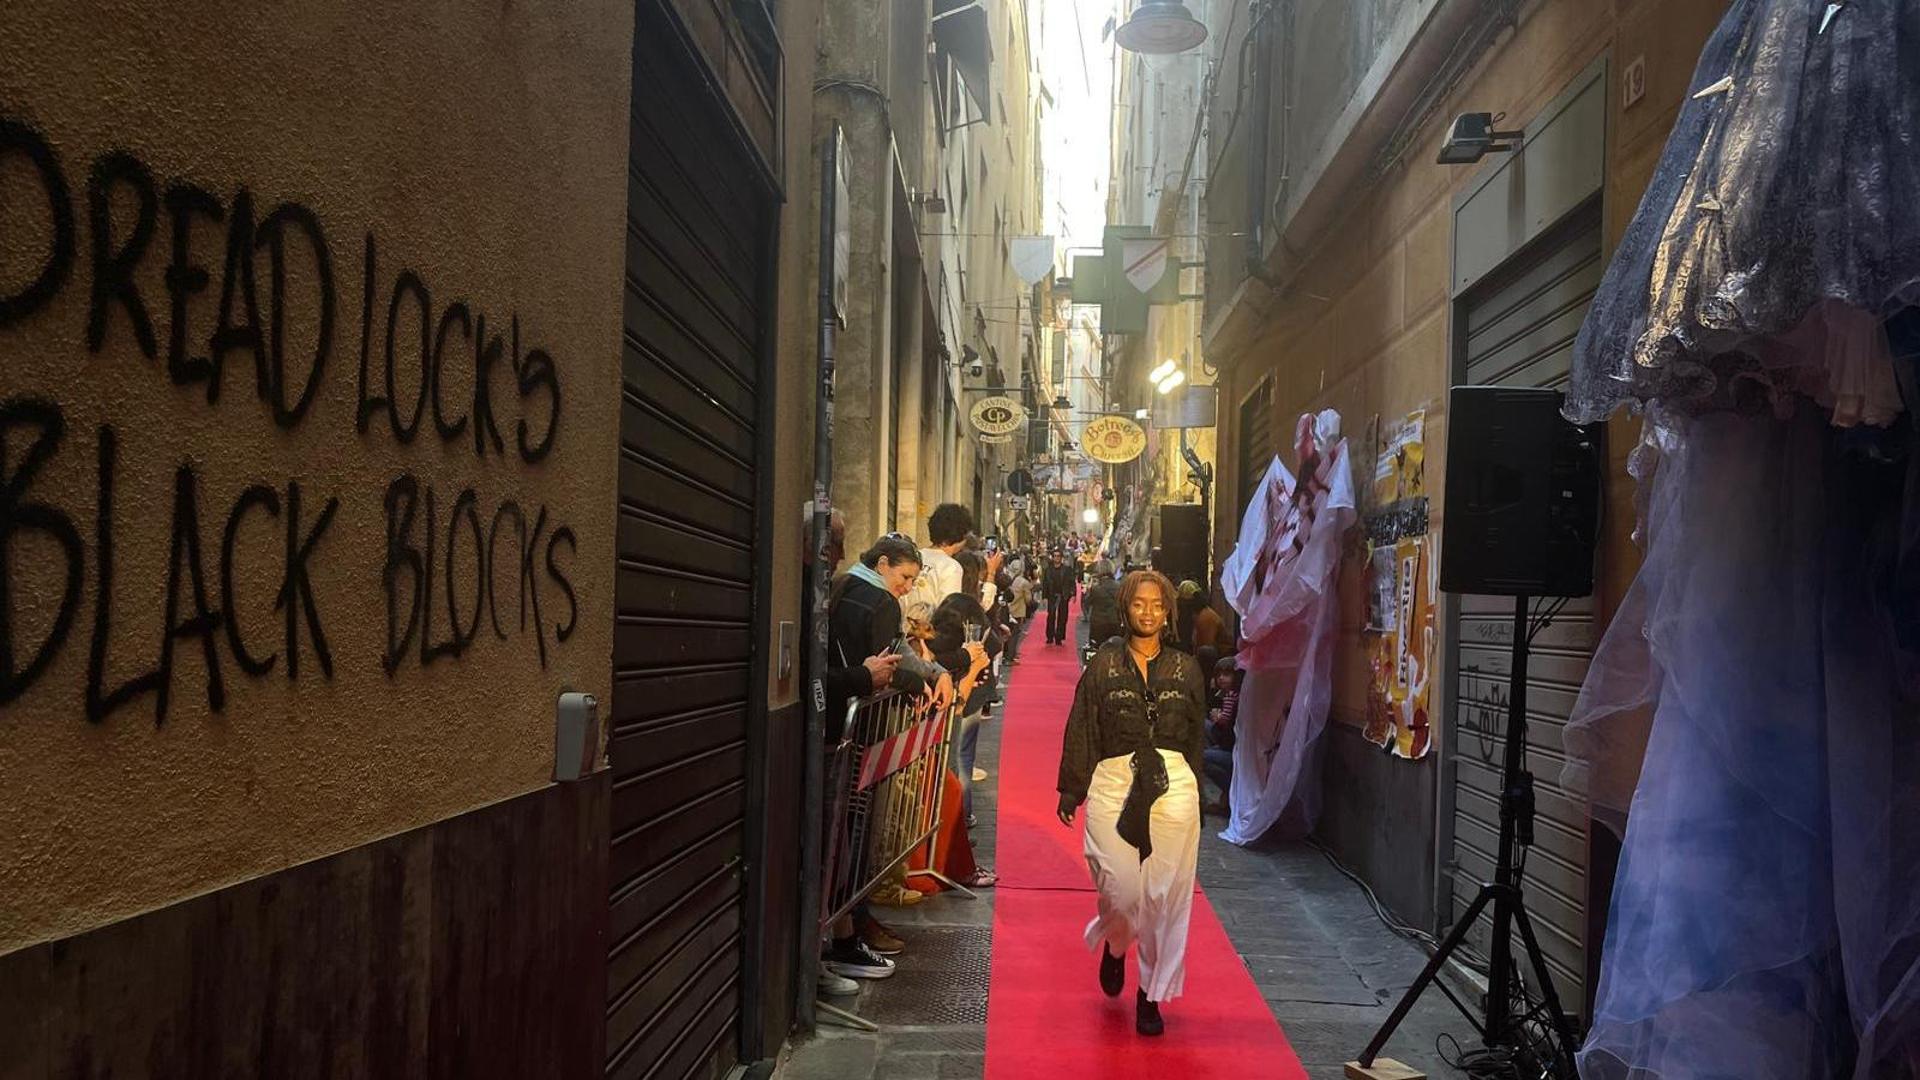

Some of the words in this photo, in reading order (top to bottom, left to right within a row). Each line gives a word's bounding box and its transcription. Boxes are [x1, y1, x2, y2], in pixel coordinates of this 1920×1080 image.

[1625, 64, 1643, 102] 19
[0, 395, 337, 728] BLACK
[383, 474, 577, 672] BLOCKS
